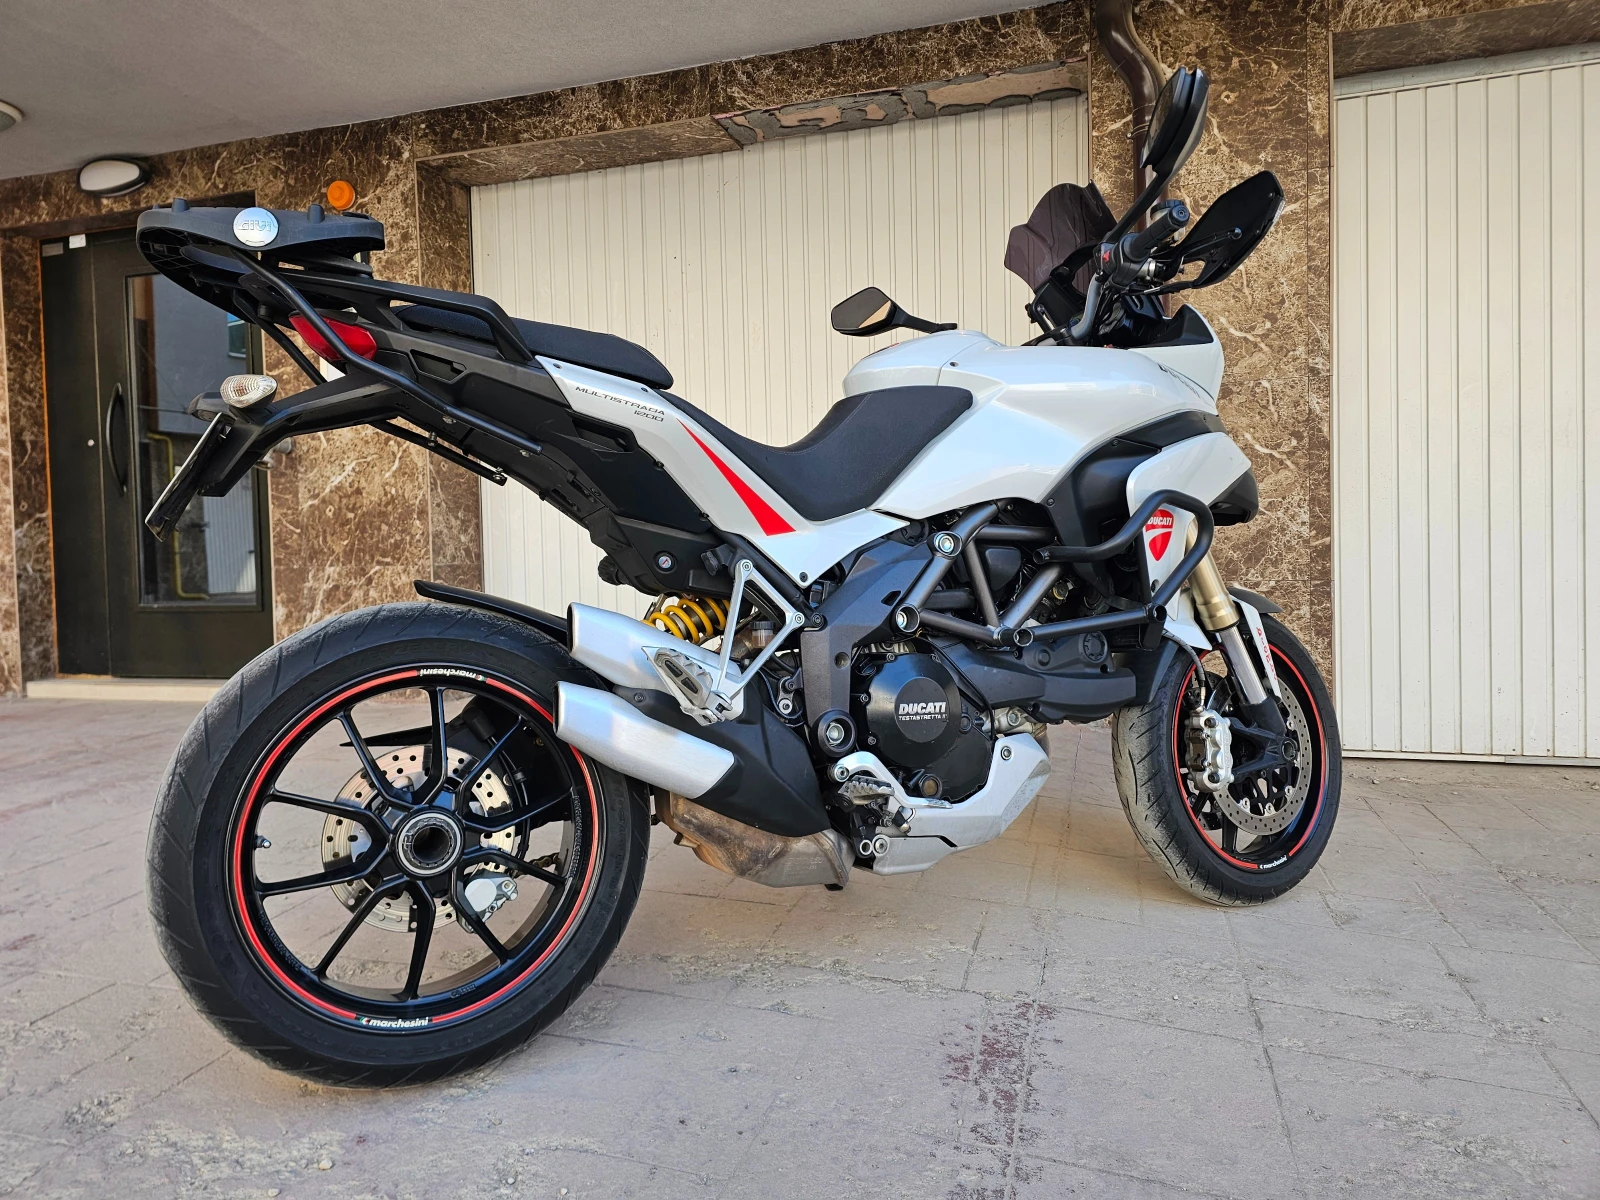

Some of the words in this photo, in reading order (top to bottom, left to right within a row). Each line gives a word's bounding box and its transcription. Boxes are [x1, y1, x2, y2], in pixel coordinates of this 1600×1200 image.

[575, 386, 665, 415] MULTISTRADA
[634, 410, 664, 422] 1200
[1147, 516, 1173, 526] DUCATI
[420, 668, 477, 678] marchesini
[899, 701, 946, 714] DUCATI
[369, 1017, 429, 1028] marchesini
